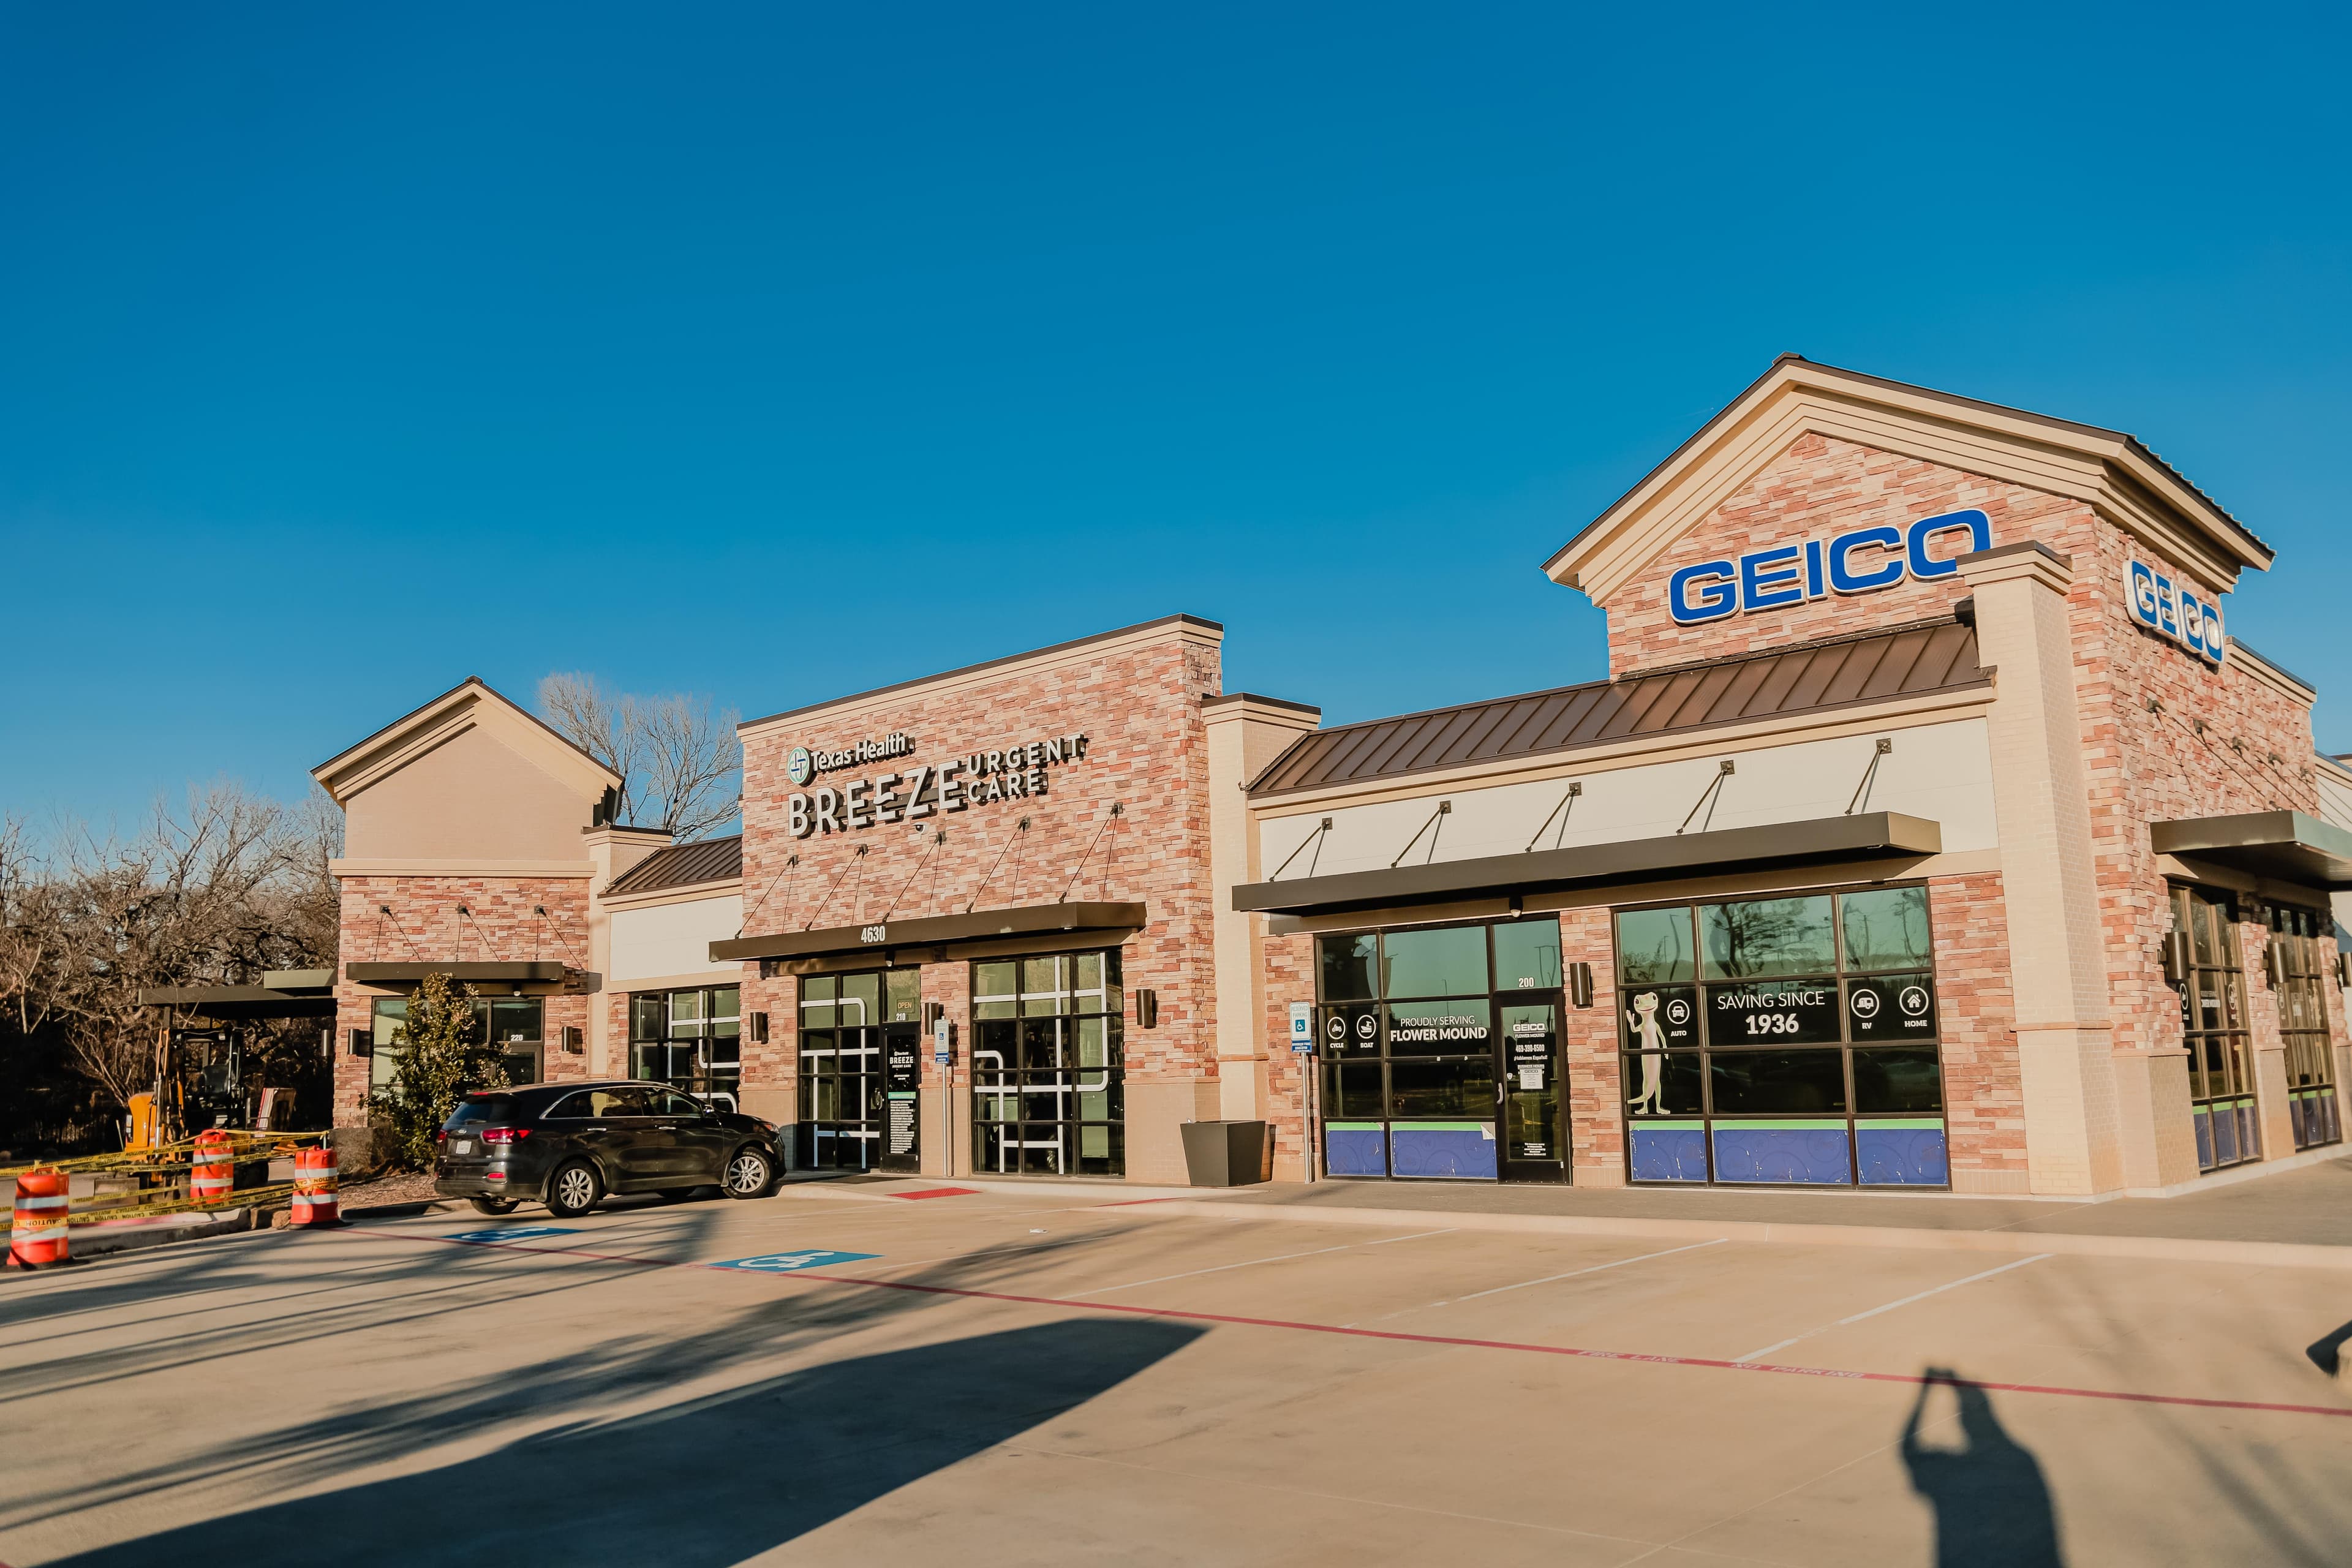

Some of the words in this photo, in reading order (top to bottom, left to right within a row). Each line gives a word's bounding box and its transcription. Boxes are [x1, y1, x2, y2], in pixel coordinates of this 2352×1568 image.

[1667, 508, 1994, 624] GEICO
[811, 749, 852, 771] Texas
[855, 732, 906, 761] Health
[967, 734, 1083, 775] URGENT
[967, 768, 1041, 802] CARE
[788, 760, 960, 837] BREEZE
[861, 925, 886, 943] 4630
[1518, 977, 1534, 988] 200
[1717, 993, 1774, 1009] SAVING
[1778, 991, 1825, 1007] SINCE
[896, 1012, 906, 1021] 210
[1400, 1017, 1439, 1027] PROUDLY
[1439, 1015, 1476, 1025] SERVING
[1745, 1013, 1799, 1035] 1936
[1390, 1028, 1438, 1041] FLOWER
[1439, 1027, 1488, 1040] MOUND
[1512, 1023, 1545, 1031] GEICO
[1577, 1349, 1626, 1359] FIRE
[1630, 1355, 1686, 1363] LANE
[1771, 1366, 1865, 1378] PARKING
